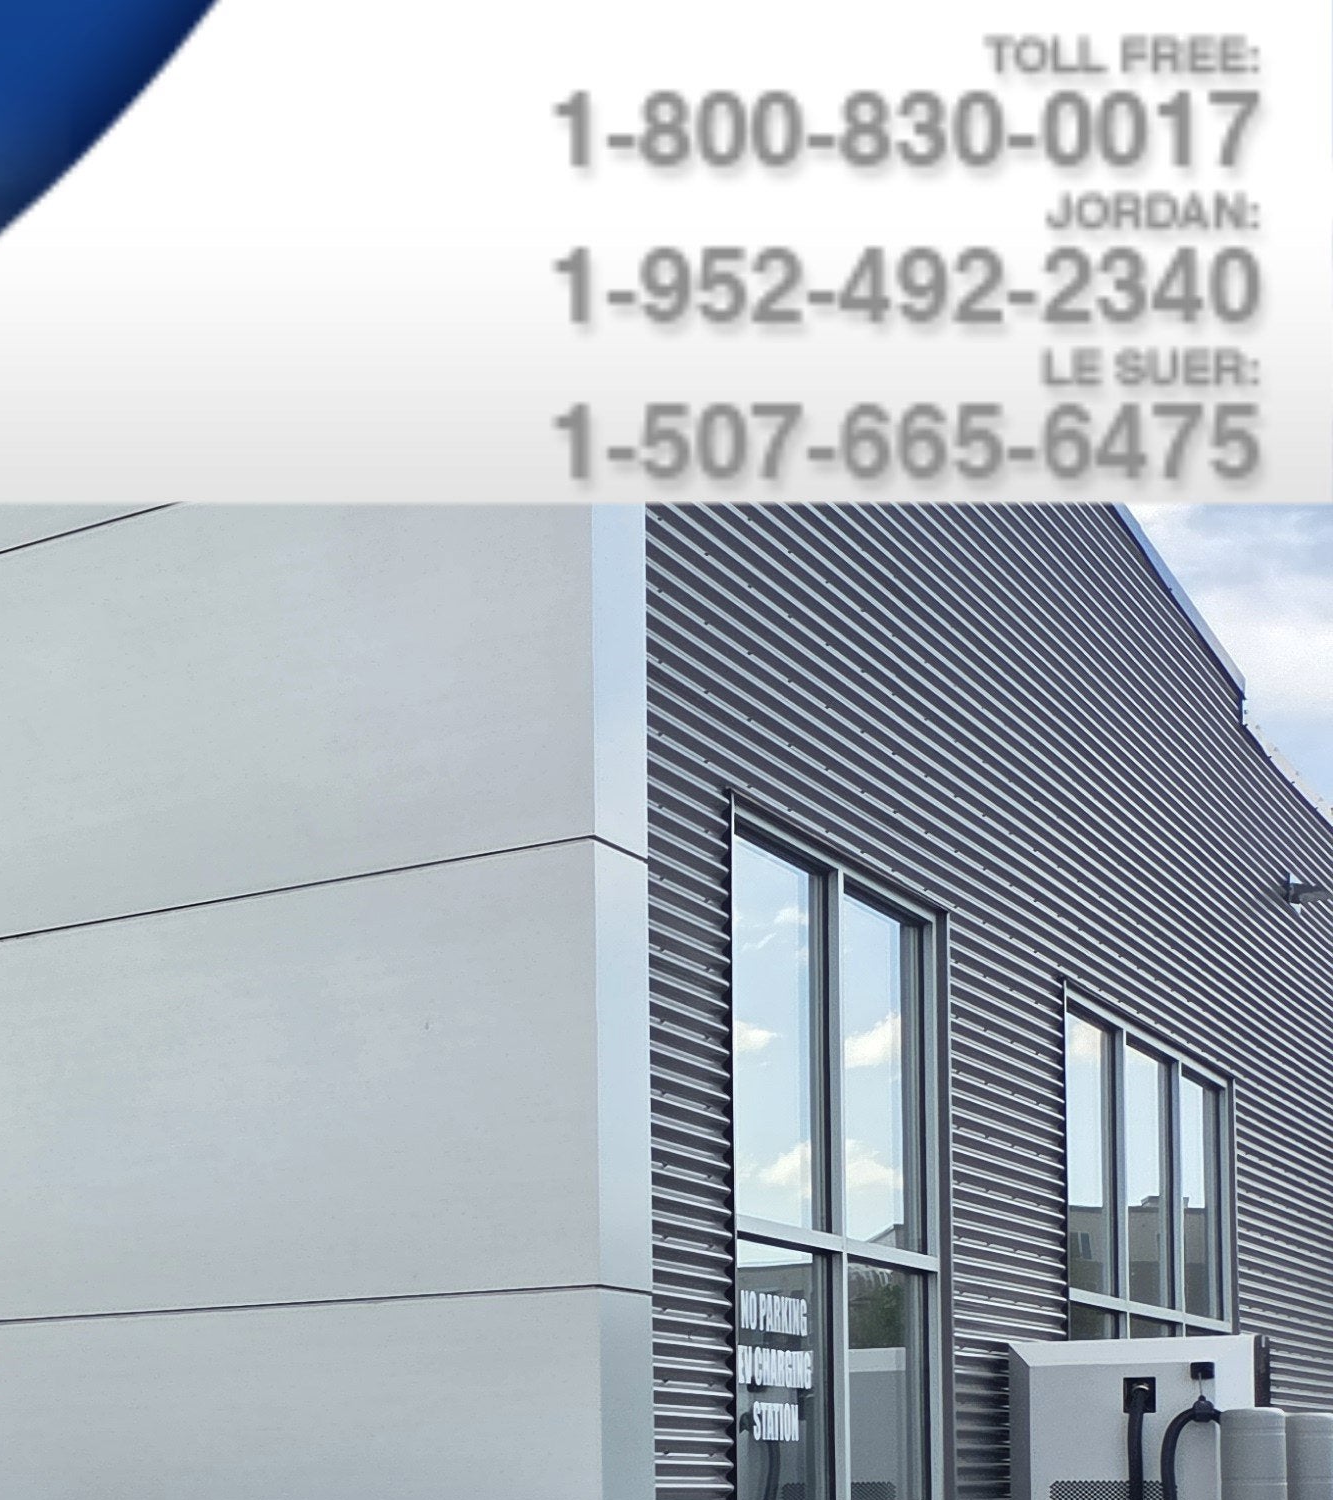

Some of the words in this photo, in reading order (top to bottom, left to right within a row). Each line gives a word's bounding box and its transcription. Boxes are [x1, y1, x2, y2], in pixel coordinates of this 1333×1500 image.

[740, 1289, 758, 1330] NO
[759, 1293, 808, 1336] PARKING
[737, 1344, 753, 1384] EV
[754, 1346, 813, 1389] CHARGING
[753, 1401, 800, 1441] STATION
